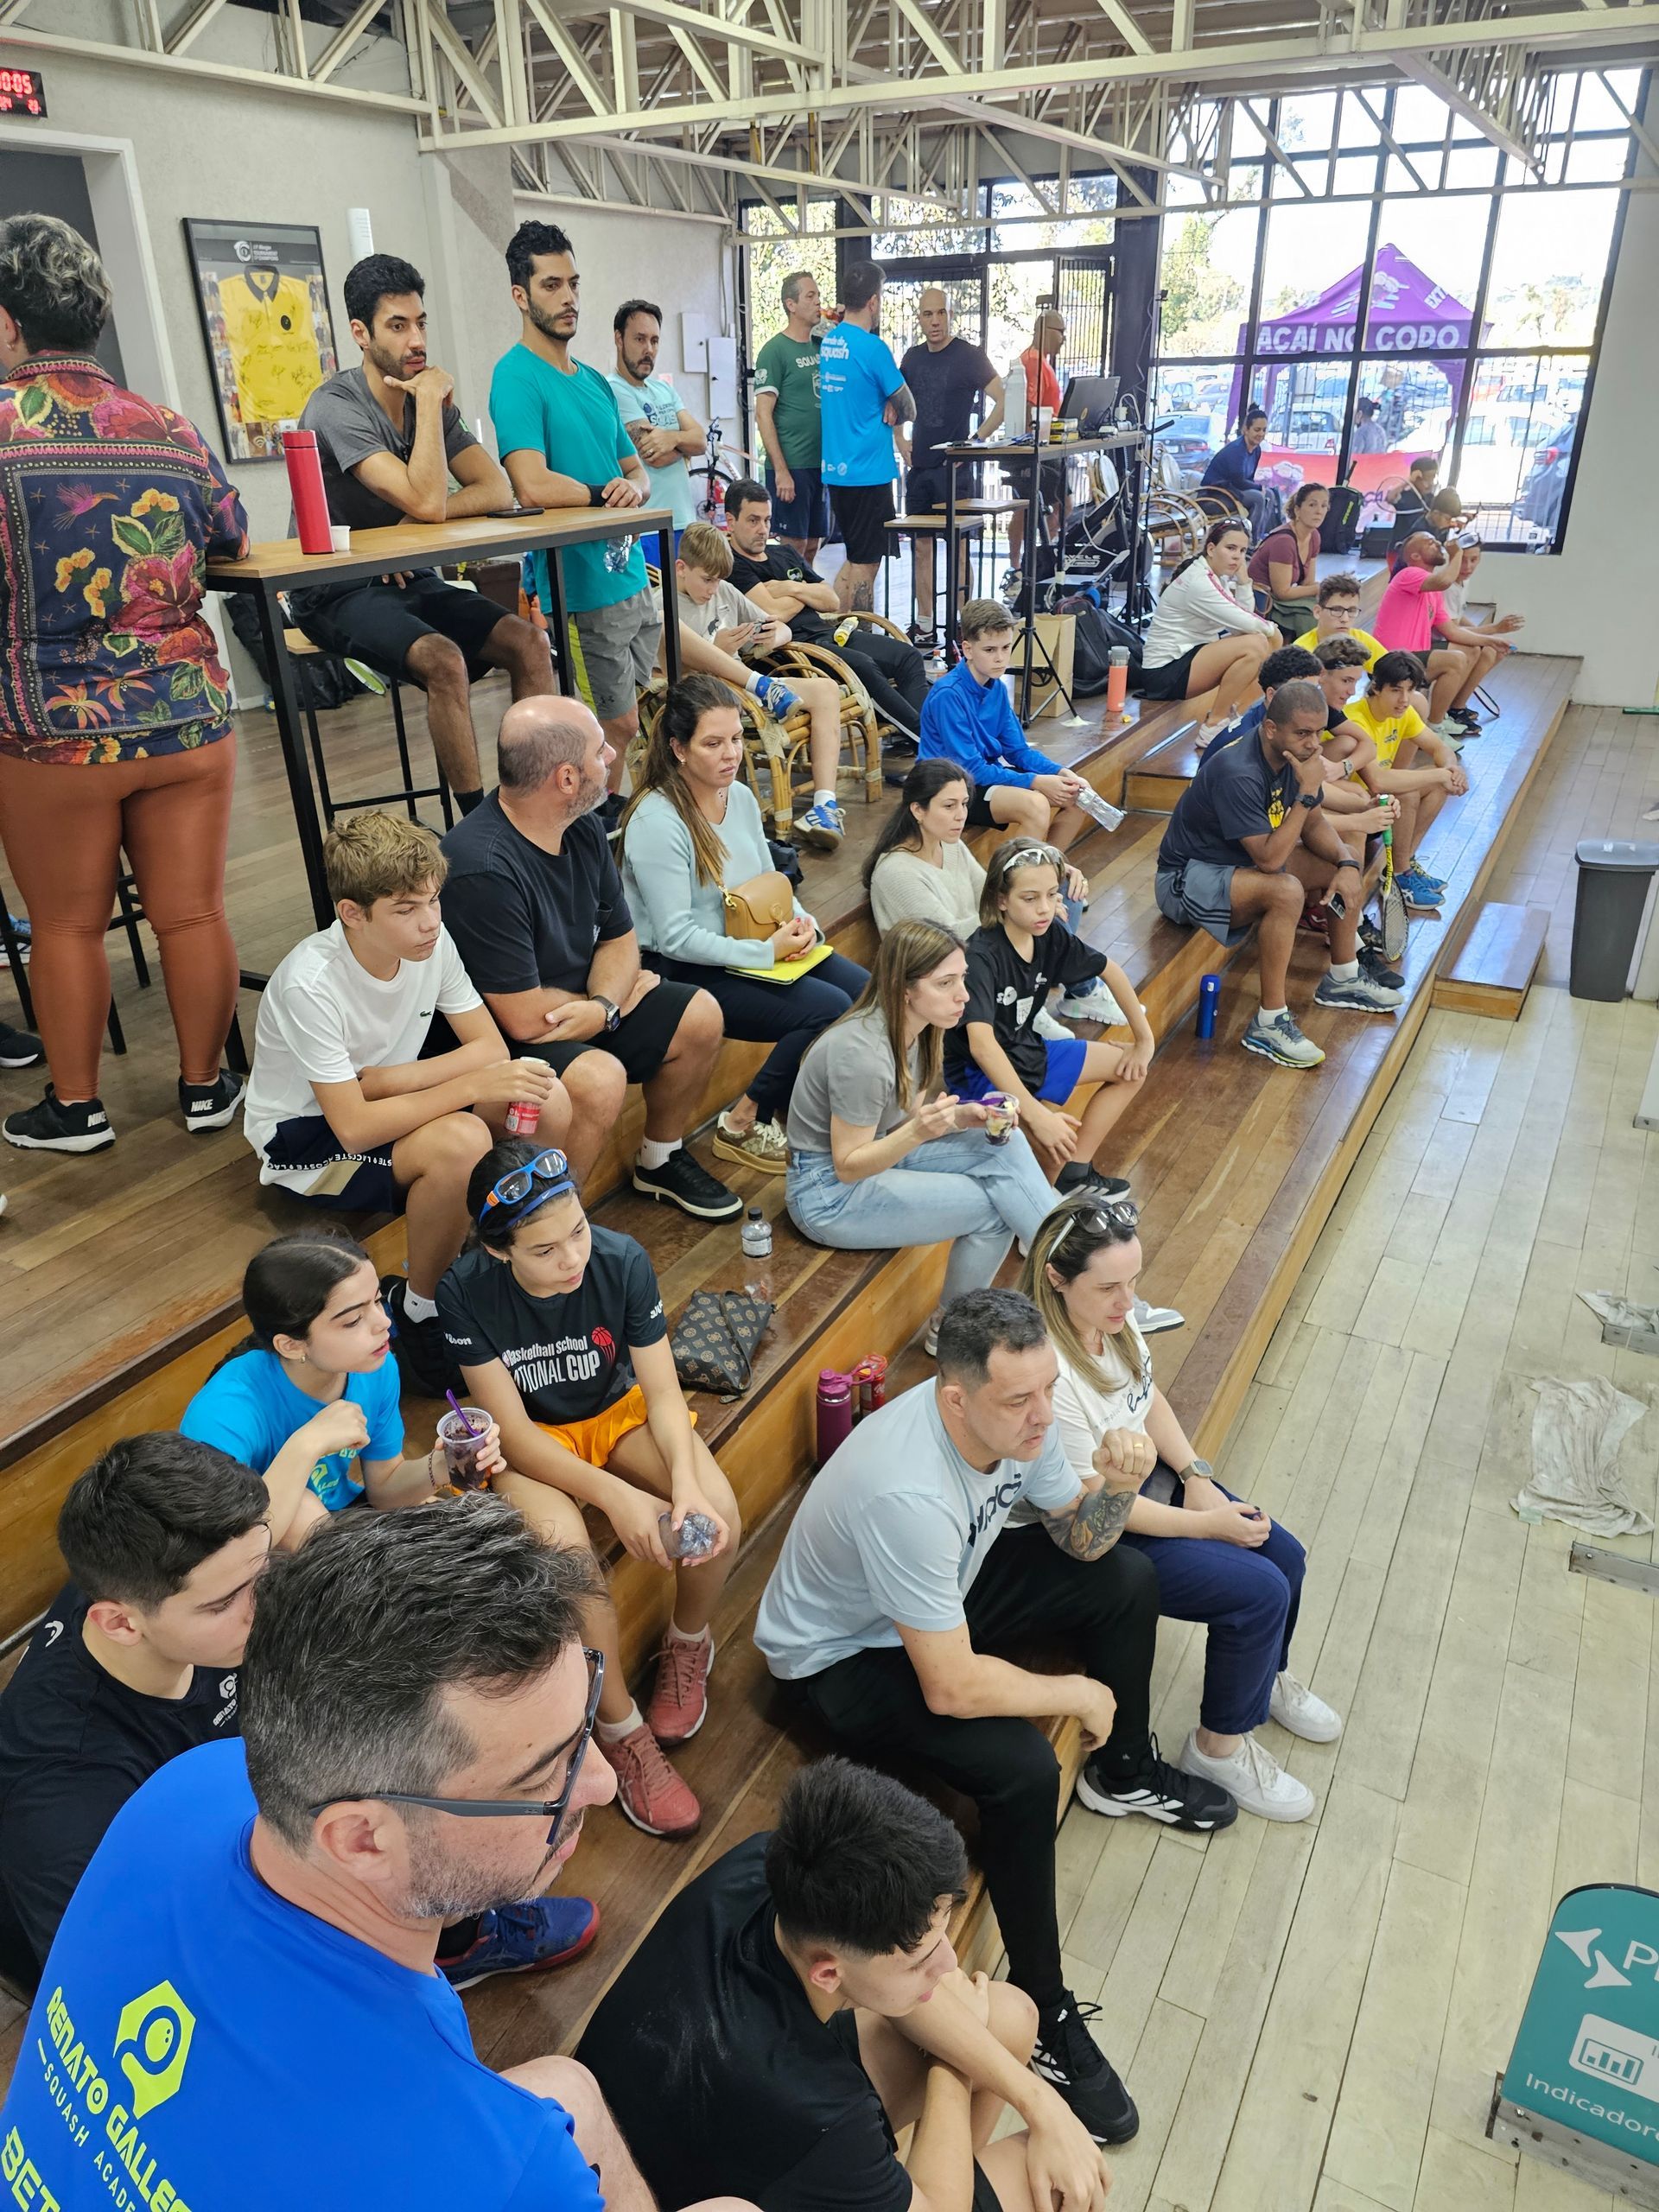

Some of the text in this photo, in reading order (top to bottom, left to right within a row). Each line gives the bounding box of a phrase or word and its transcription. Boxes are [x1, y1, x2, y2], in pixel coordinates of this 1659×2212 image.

[87, 1111, 107, 1128] NIKE
[191, 1099, 213, 1113] NIKE
[509, 1350, 601, 1394] ATIONAL CUP
[47, 1986, 109, 2114] RENATO
[45, 2063, 90, 2147] SQUASH
